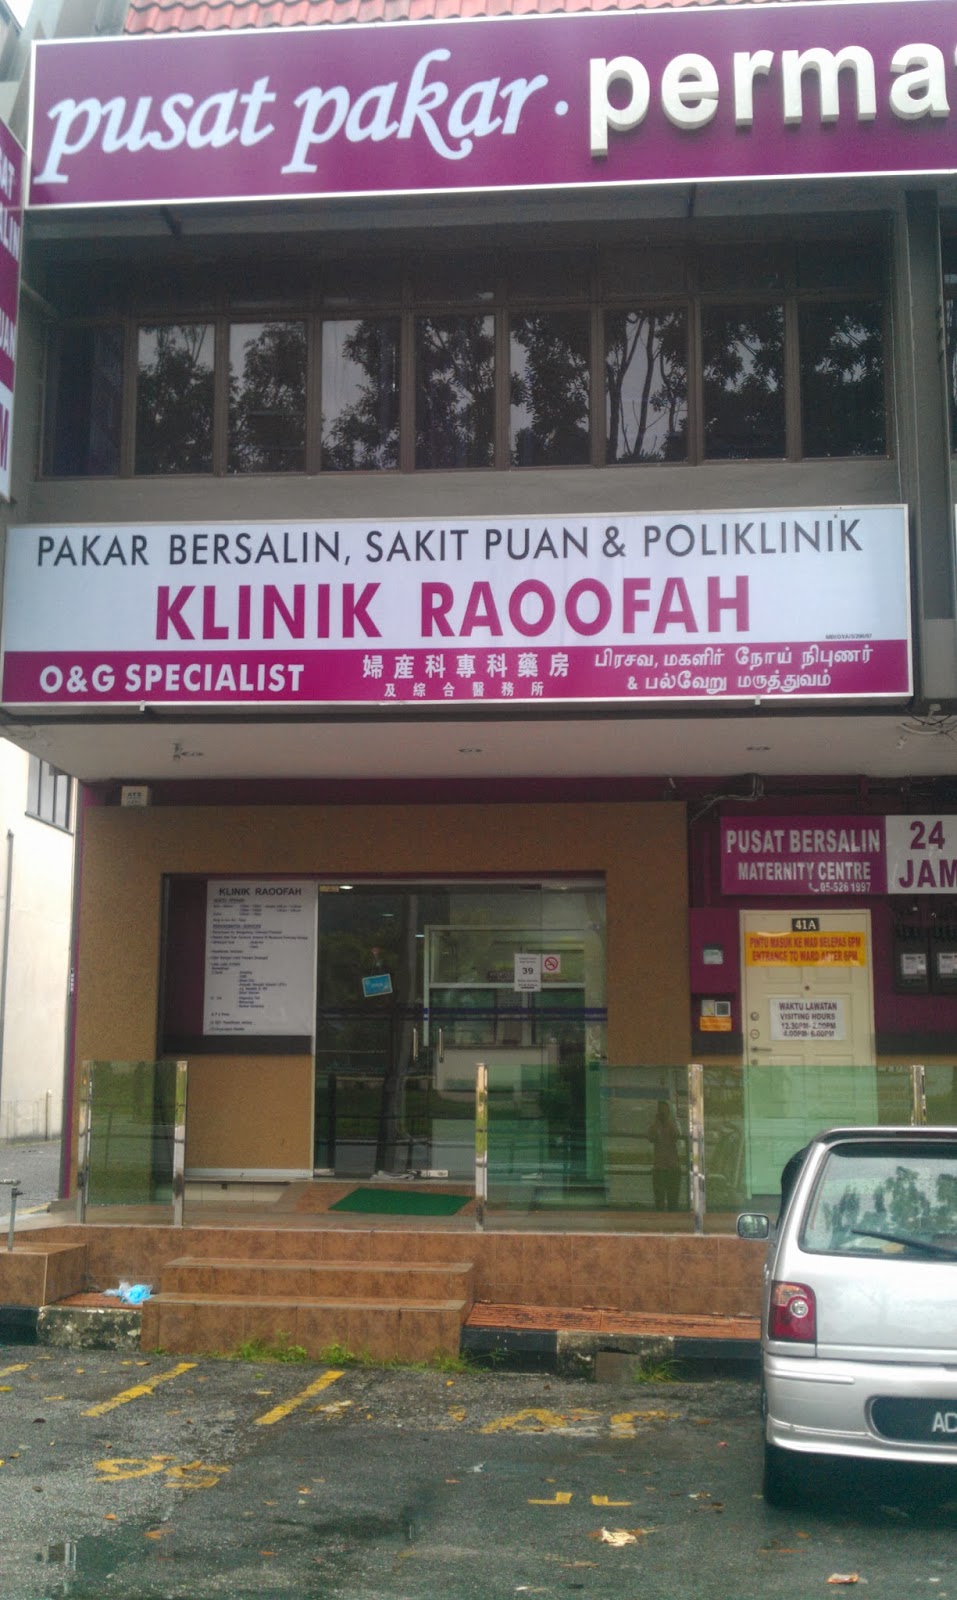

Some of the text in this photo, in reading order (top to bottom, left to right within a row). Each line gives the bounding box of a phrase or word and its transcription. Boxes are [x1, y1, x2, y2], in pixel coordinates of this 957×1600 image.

[34, 76, 275, 183] pusat
[281, 49, 549, 174] pakar
[37, 518, 863, 567] PAKAR BERSALIN, SAKIT PUAN & POLIKLINIK
[155, 575, 751, 641] KLINIK RAOOFAH
[39, 663, 305, 694] O&G SPECIALIST
[726, 830, 880, 853] PUSAT BERSALIN
[910, 821, 946, 850] 24
[738, 862, 871, 880] MATERNITY CENTRE
[219, 887, 302, 896] KLINIK RAOOFAH
[851, 883, 871, 892] 1997
[795, 919, 817, 930] 41A
[790, 951, 798, 962] TO
[522, 967, 534, 975] 39
[779, 1001, 838, 1010] WAKTU LAWATAN
